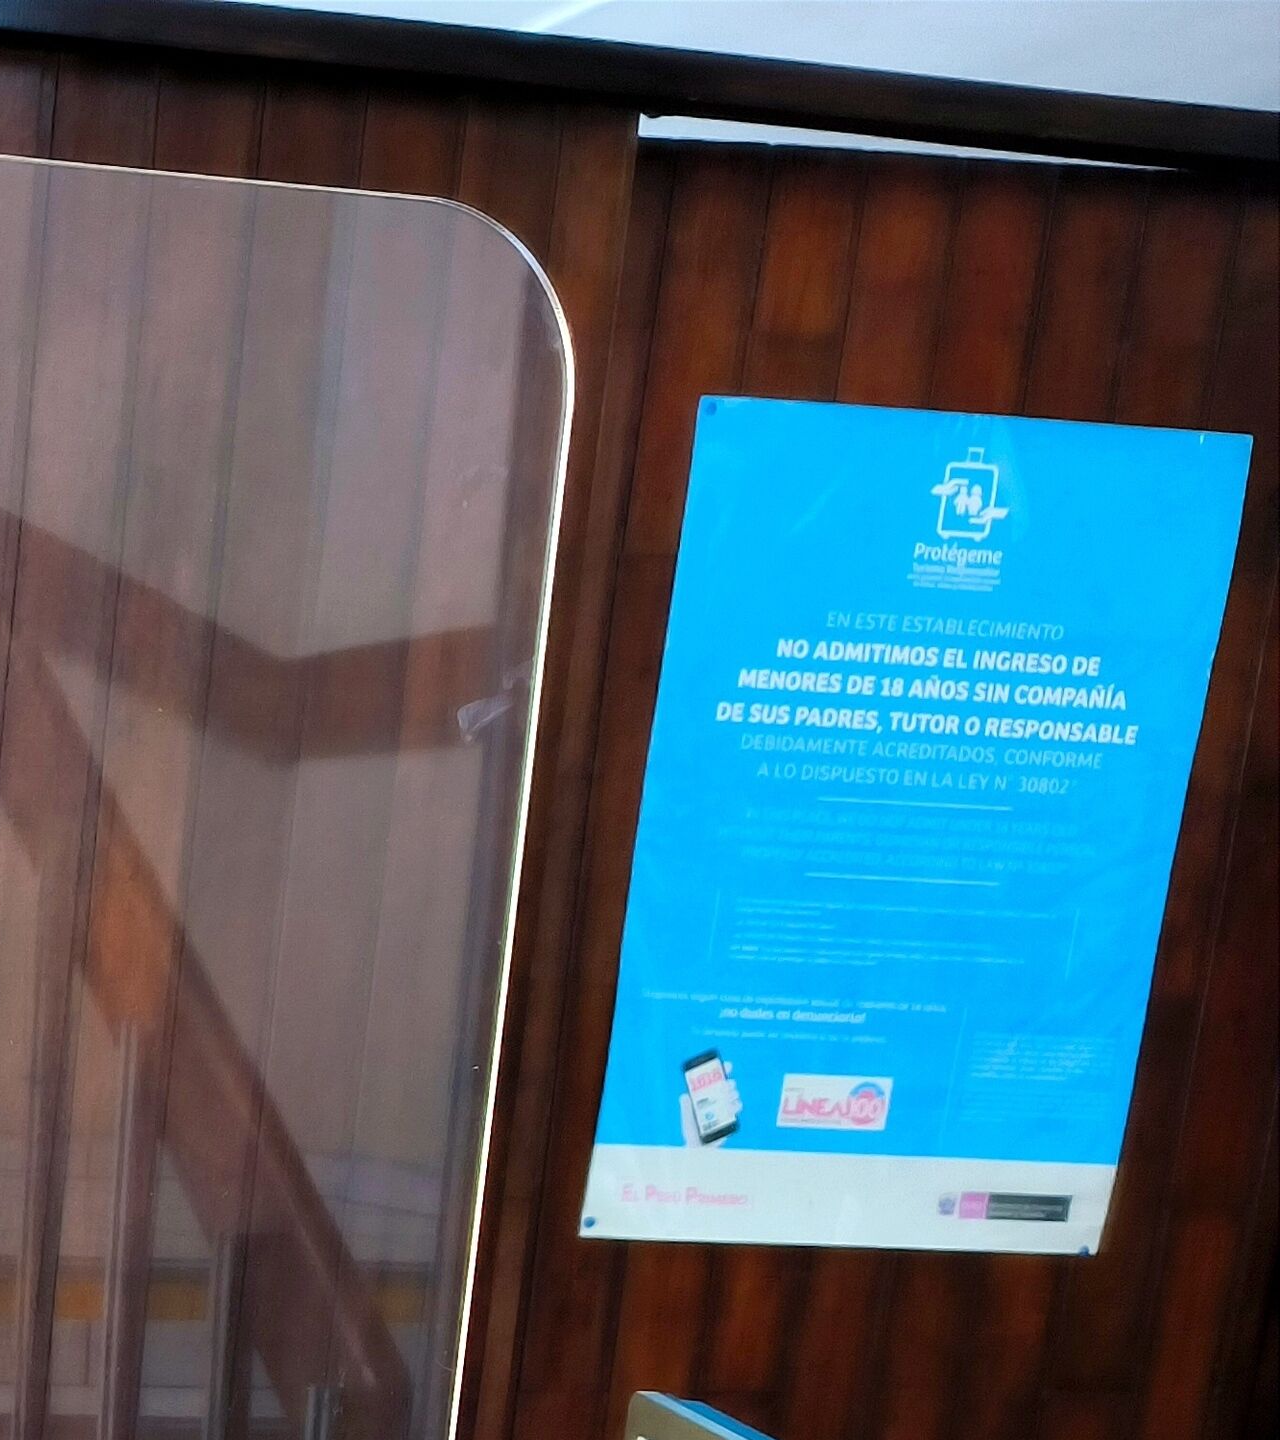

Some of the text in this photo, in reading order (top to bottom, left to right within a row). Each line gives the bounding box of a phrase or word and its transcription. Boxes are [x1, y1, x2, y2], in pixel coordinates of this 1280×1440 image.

[914, 542, 1003, 567] Protégeme
[827, 611, 1064, 641] EN ESTE ESTABLECIMIENTO
[777, 638, 1101, 677] NO ADMITIMOS EL INGRESO DE
[738, 669, 1127, 711] MENORES DE 18 AÑOS SIN COMPAÑÍA
[715, 701, 1139, 745] DE SUS PADRES, TUTOR O RESPONSABLE
[740, 733, 868, 757] DEBIDAMENTE
[1004, 749, 1102, 770] CONFORME
[757, 762, 769, 778] A
[774, 763, 796, 779] LO
[801, 764, 899, 785] DISPUESTO
[904, 769, 927, 787] EN
[932, 772, 954, 789] LA
[958, 773, 989, 790] LEY
